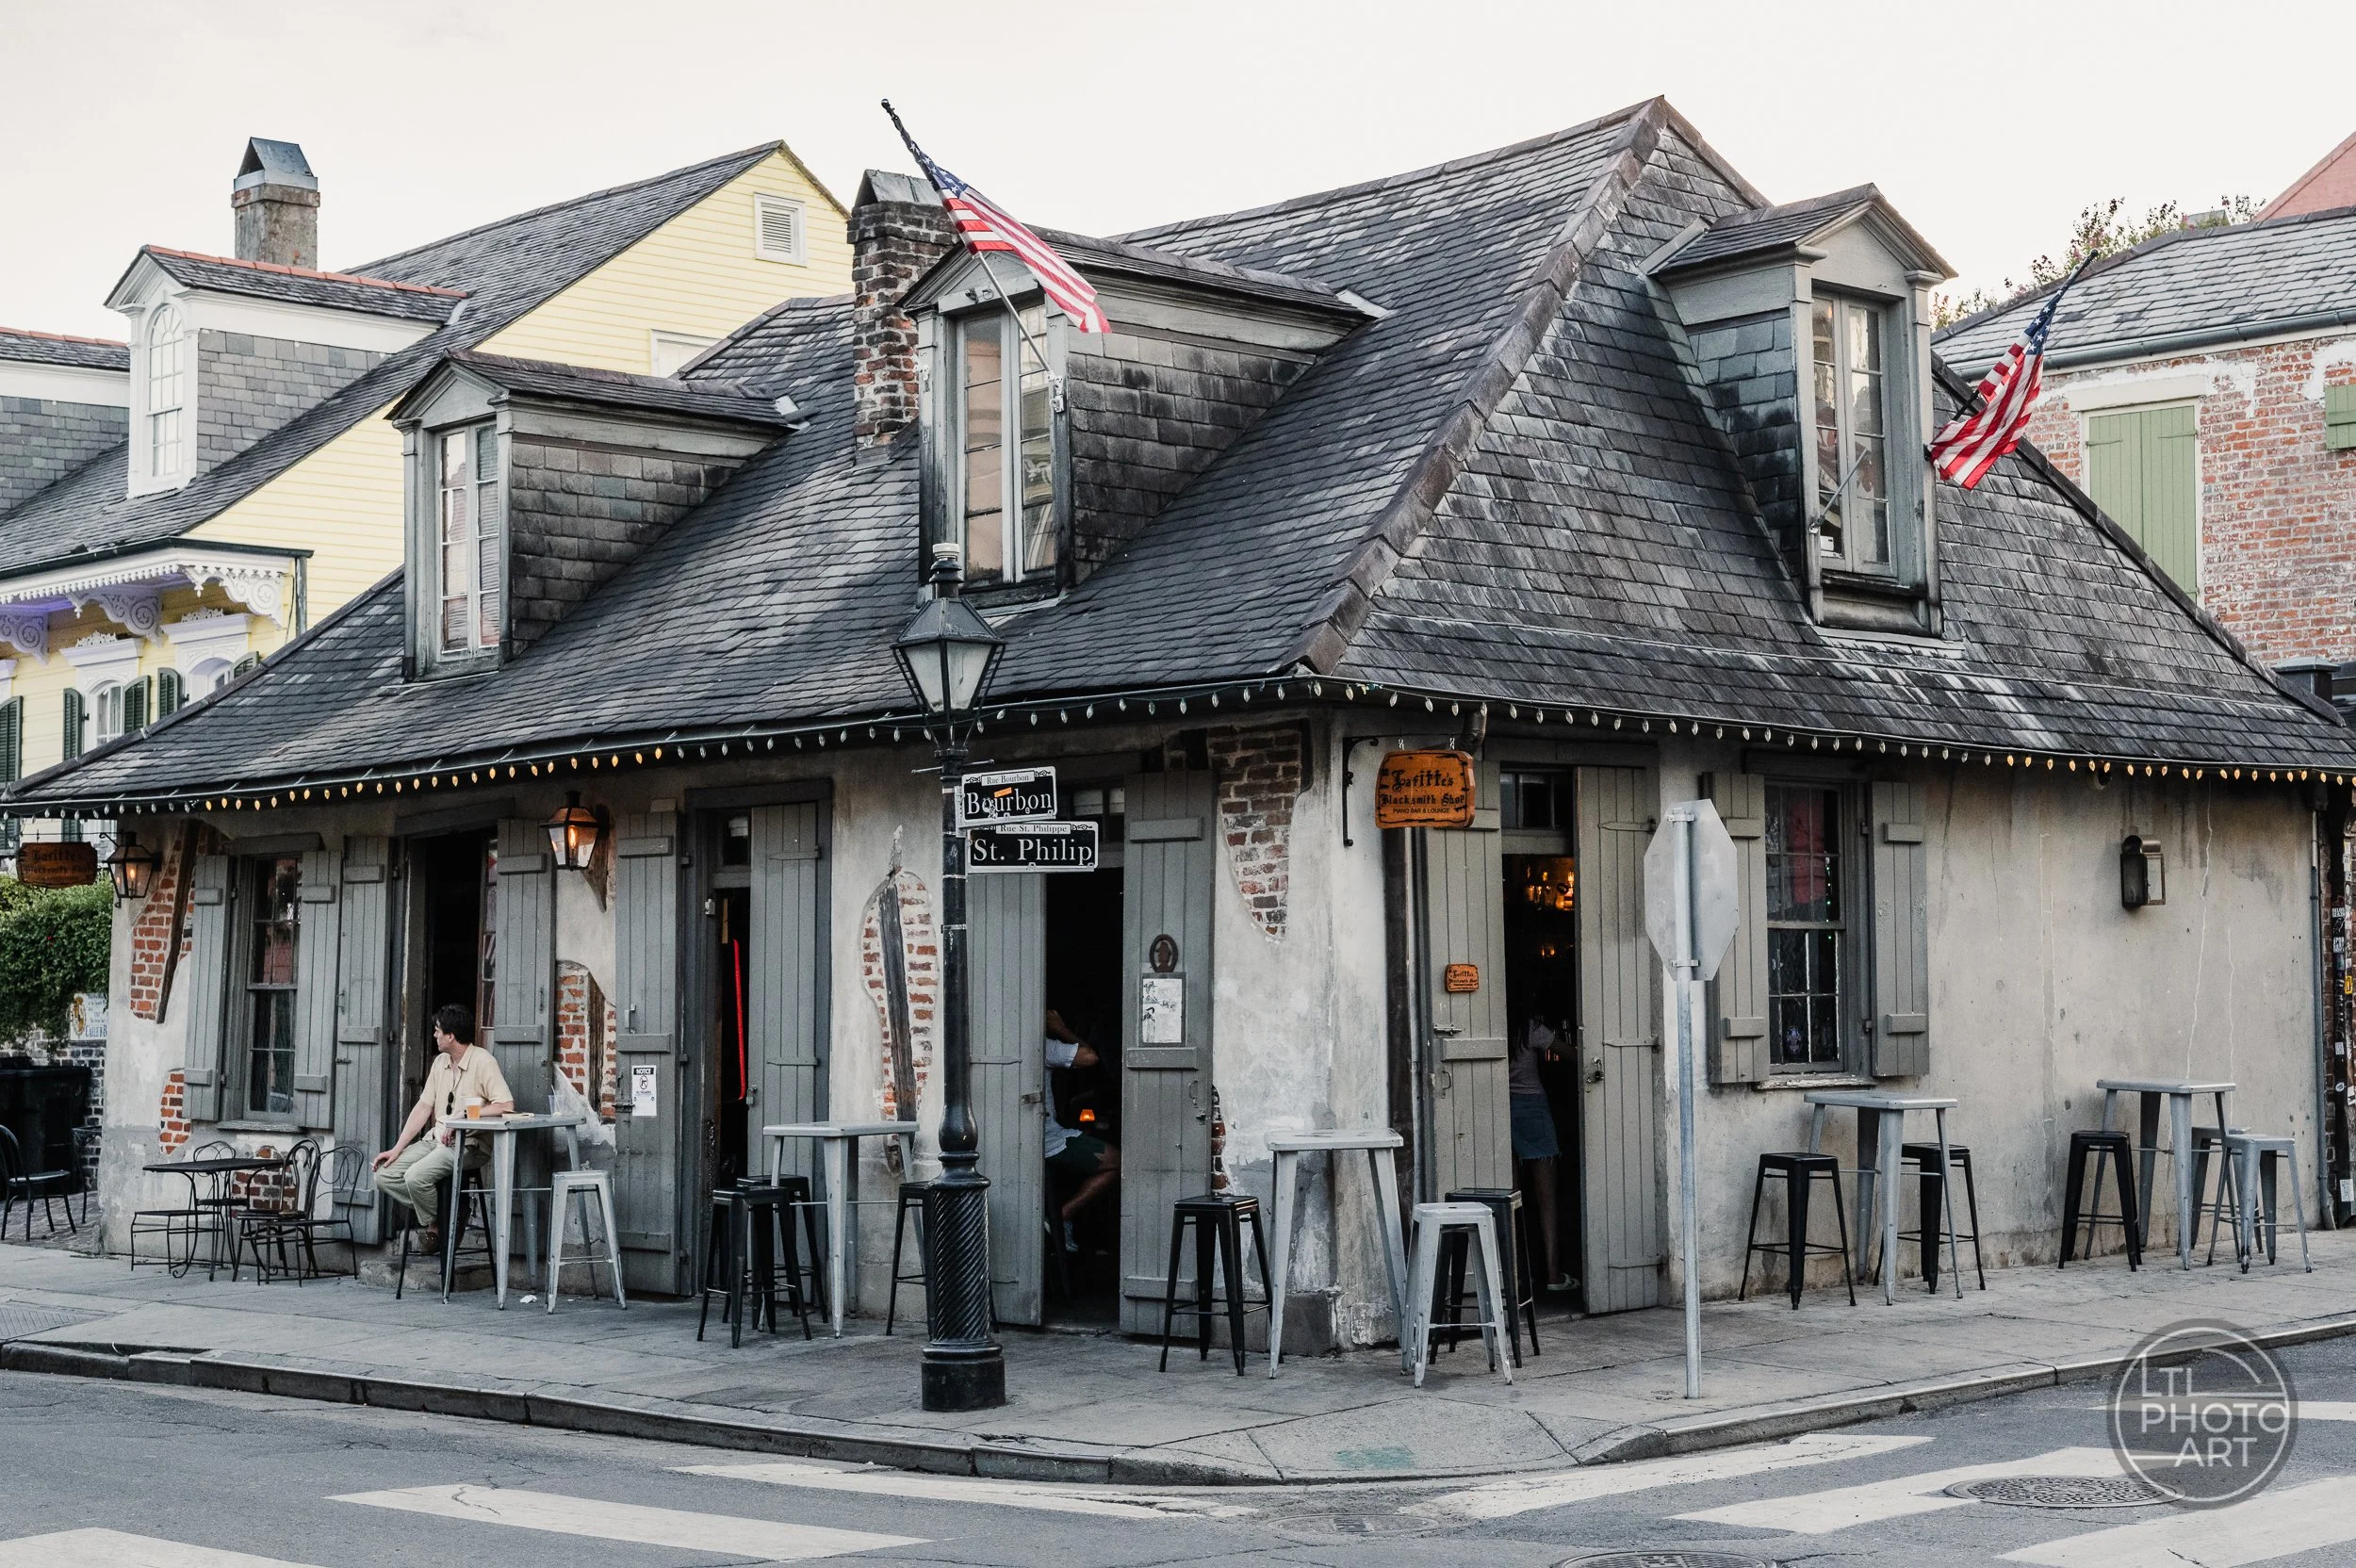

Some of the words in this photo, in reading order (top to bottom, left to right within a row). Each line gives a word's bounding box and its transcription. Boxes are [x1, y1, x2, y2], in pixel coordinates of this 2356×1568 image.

[987, 776, 999, 785] Rue
[1001, 775, 1029, 783] Bourbon
[1391, 770, 1454, 792] Lafitte's
[966, 788, 1052, 815] Bourbon
[1380, 793, 1436, 808] Blacksmith
[1441, 793, 1464, 807] Shop
[1033, 825, 1067, 834] Philippe
[973, 838, 1006, 861] St.
[1017, 839, 1092, 865] Philip
